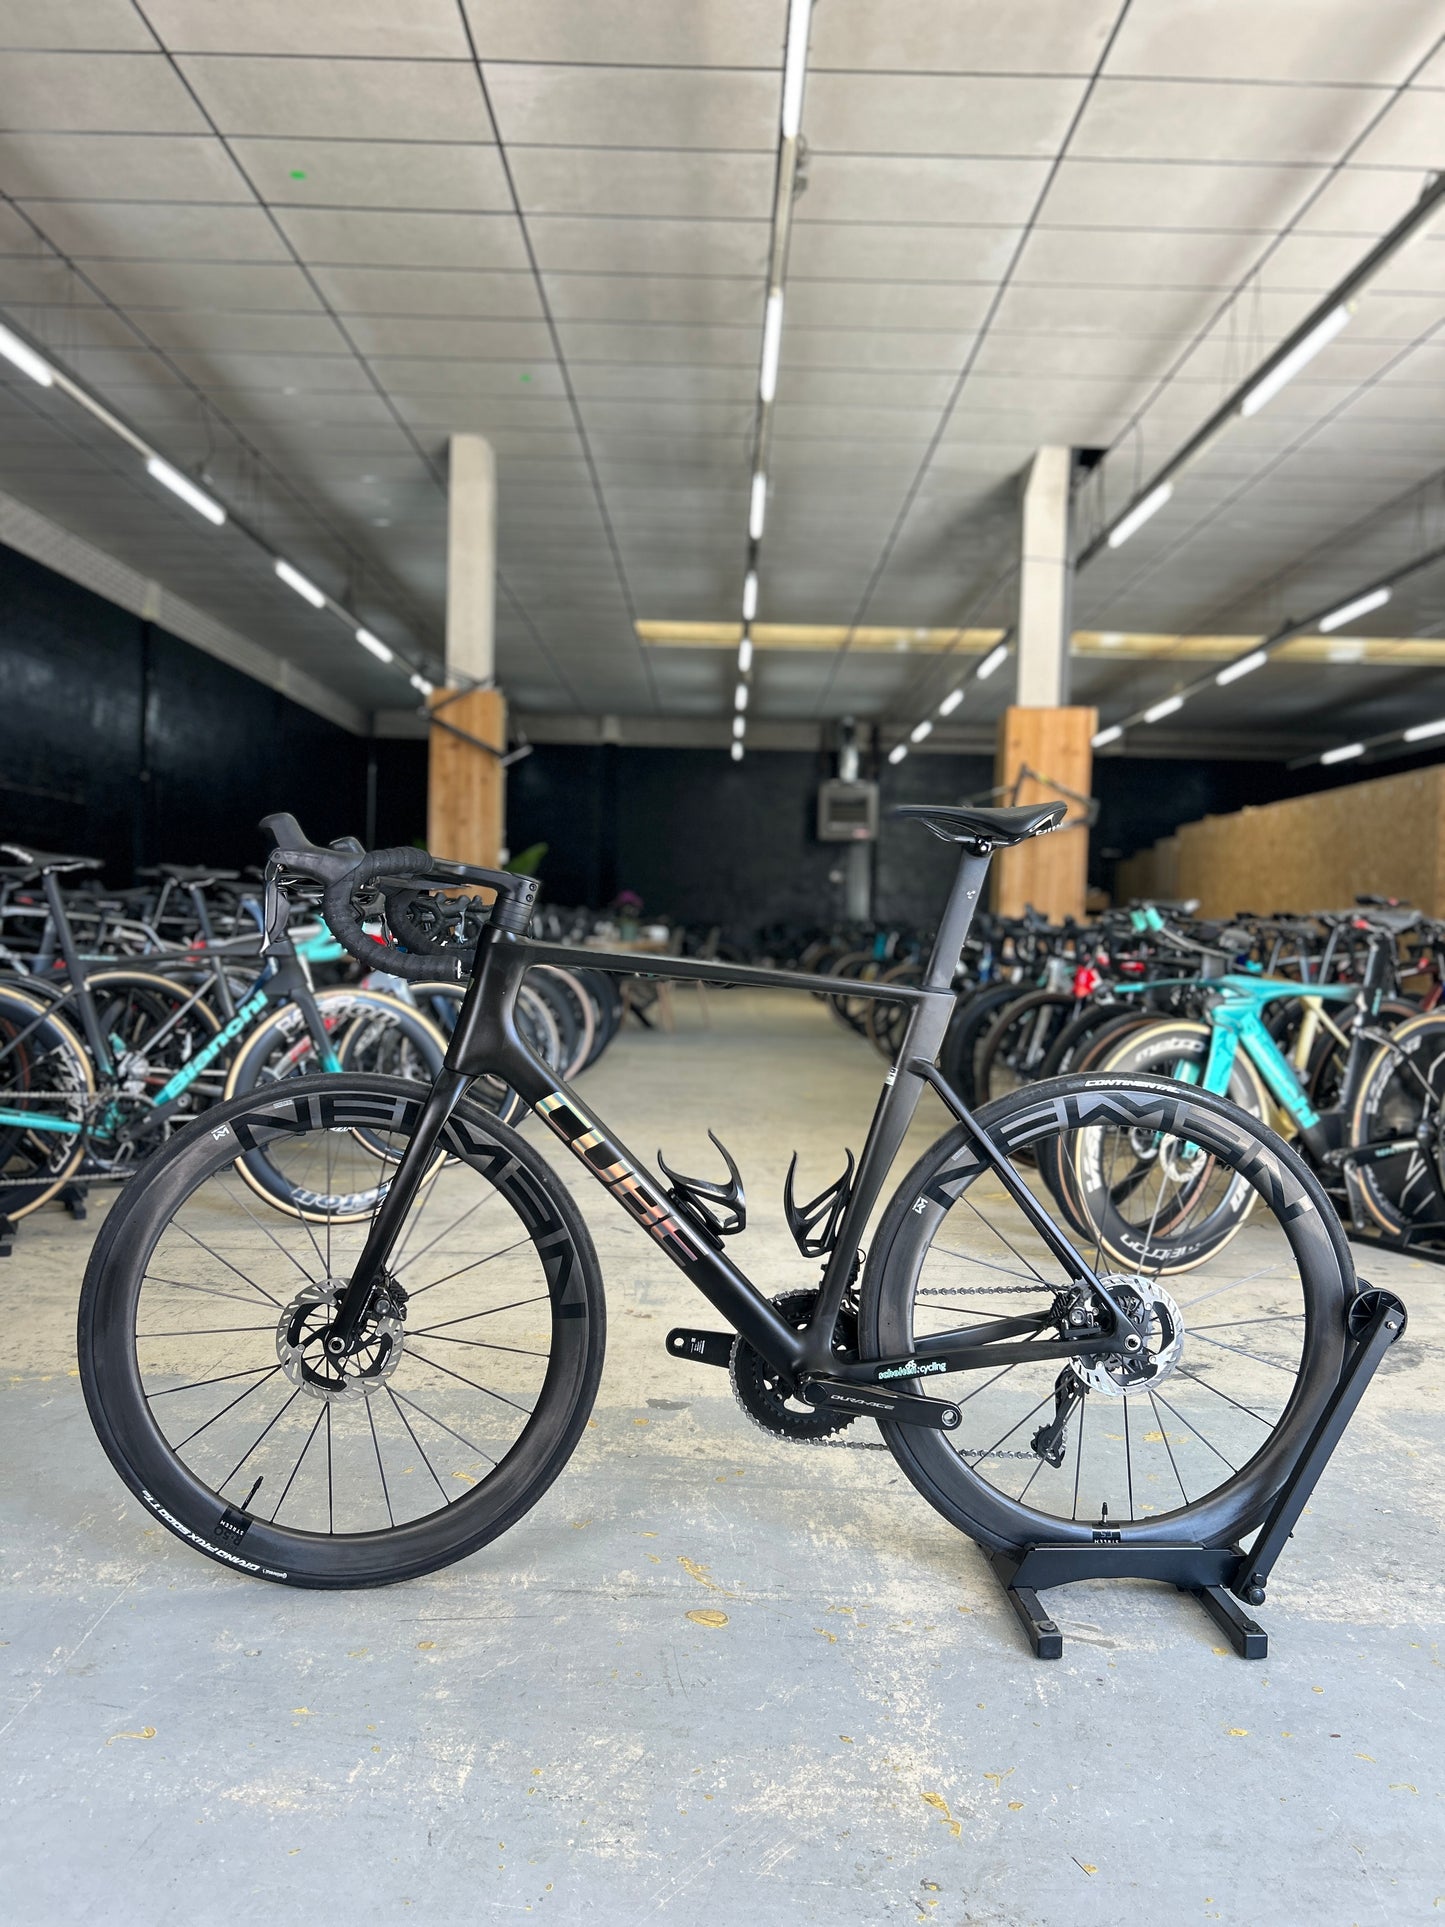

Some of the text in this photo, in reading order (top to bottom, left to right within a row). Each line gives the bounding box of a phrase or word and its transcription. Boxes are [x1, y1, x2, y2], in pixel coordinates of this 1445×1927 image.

[164, 990, 268, 1100] Bianchi
[1085, 1080, 1180, 1094] CONTINENTAL
[535, 1092, 709, 1267] CUBE
[831, 1395, 896, 1410] DURA-ACE
